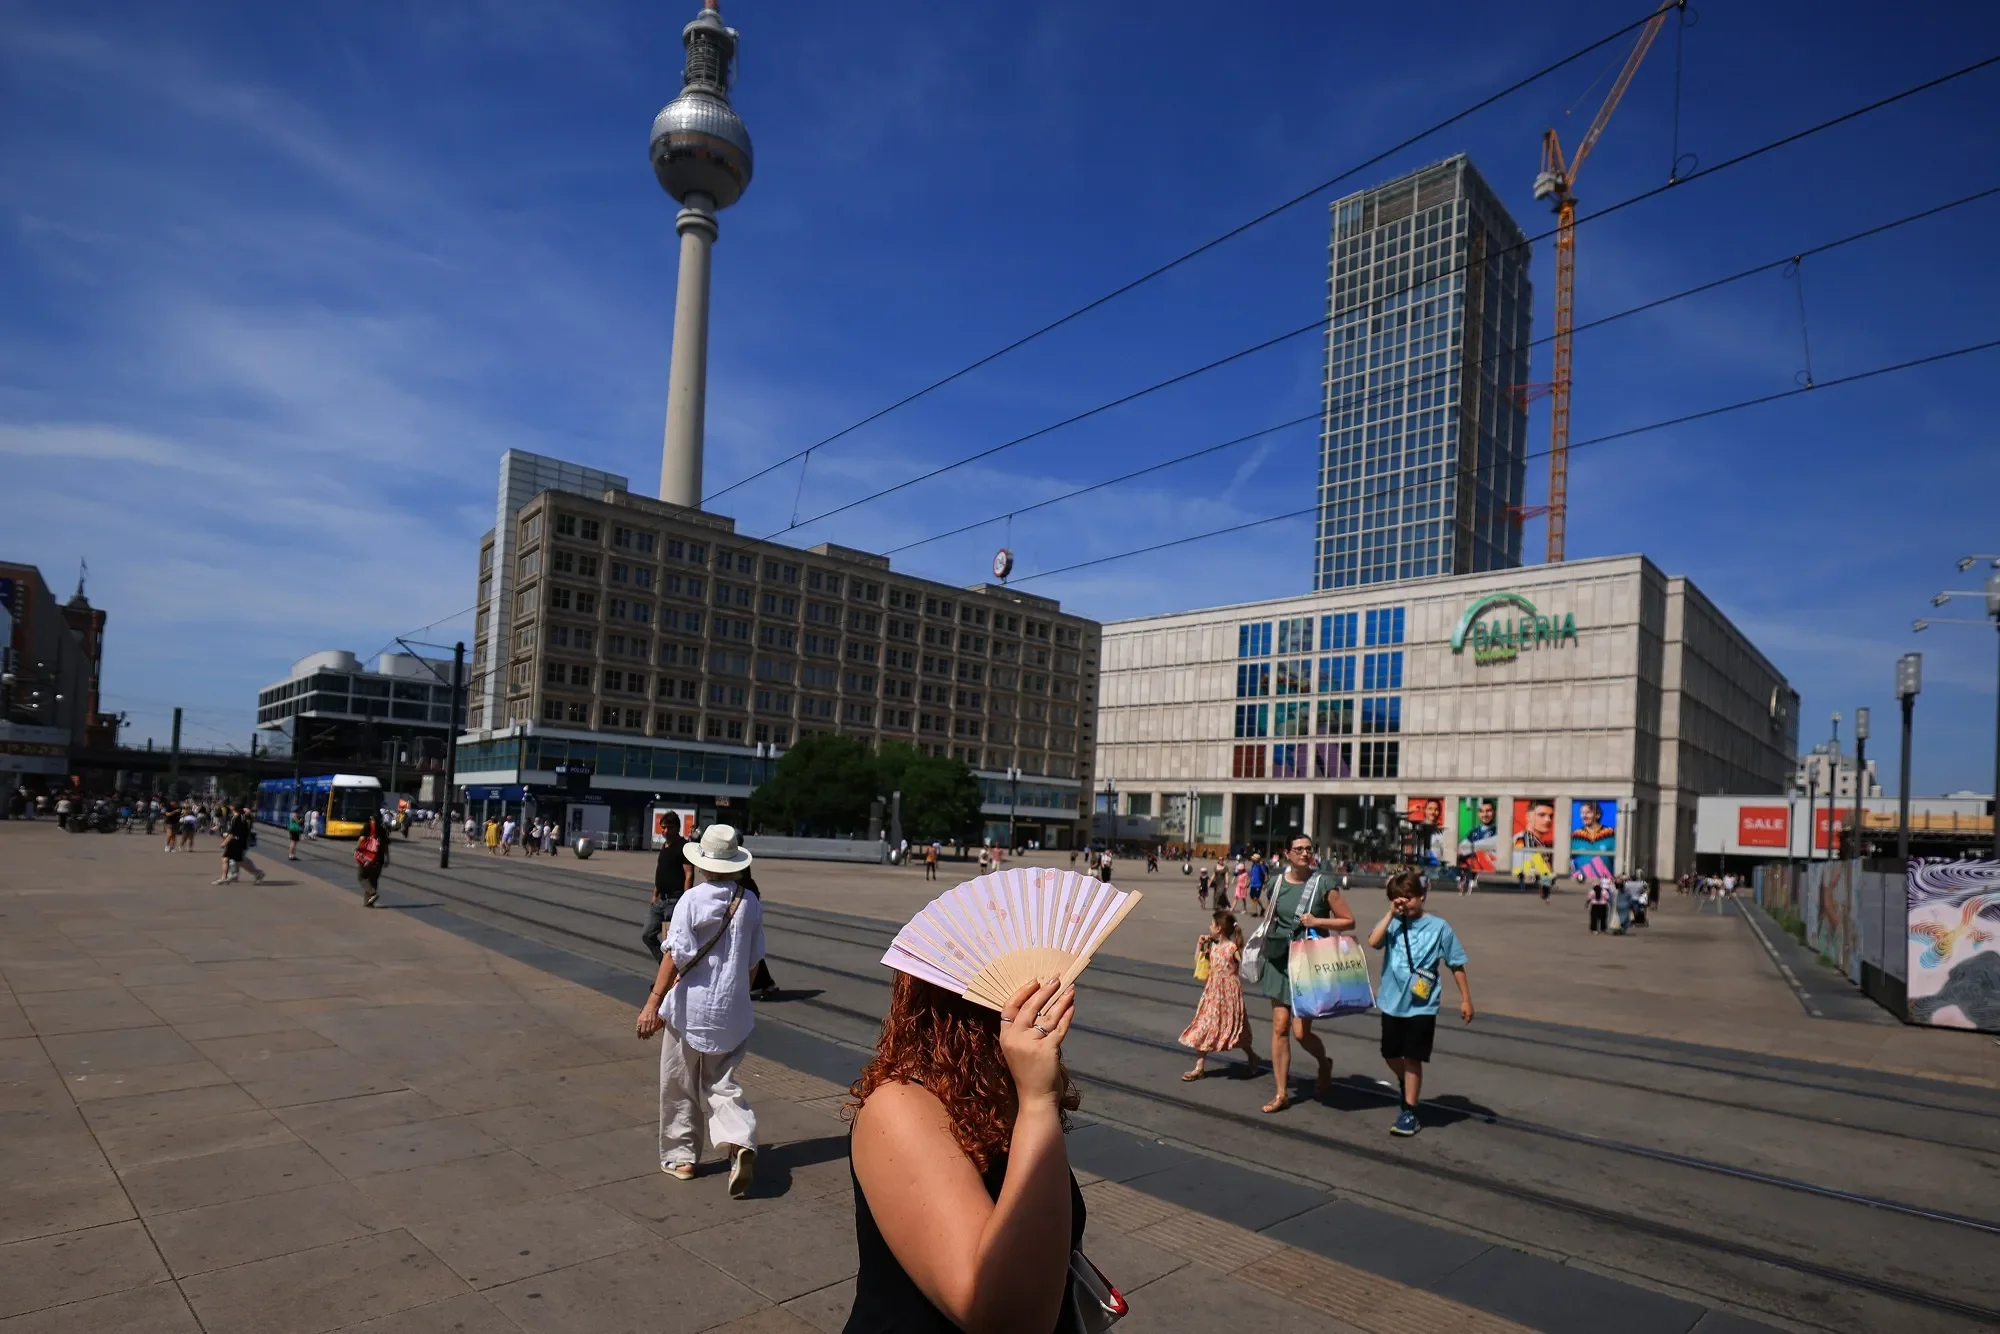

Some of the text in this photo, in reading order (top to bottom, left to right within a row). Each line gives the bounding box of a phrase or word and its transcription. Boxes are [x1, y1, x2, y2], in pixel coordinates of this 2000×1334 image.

[1473, 611, 1578, 649] GALERIA
[1743, 817, 1785, 831] SALE
[1314, 959, 1364, 974] PRIMARK
